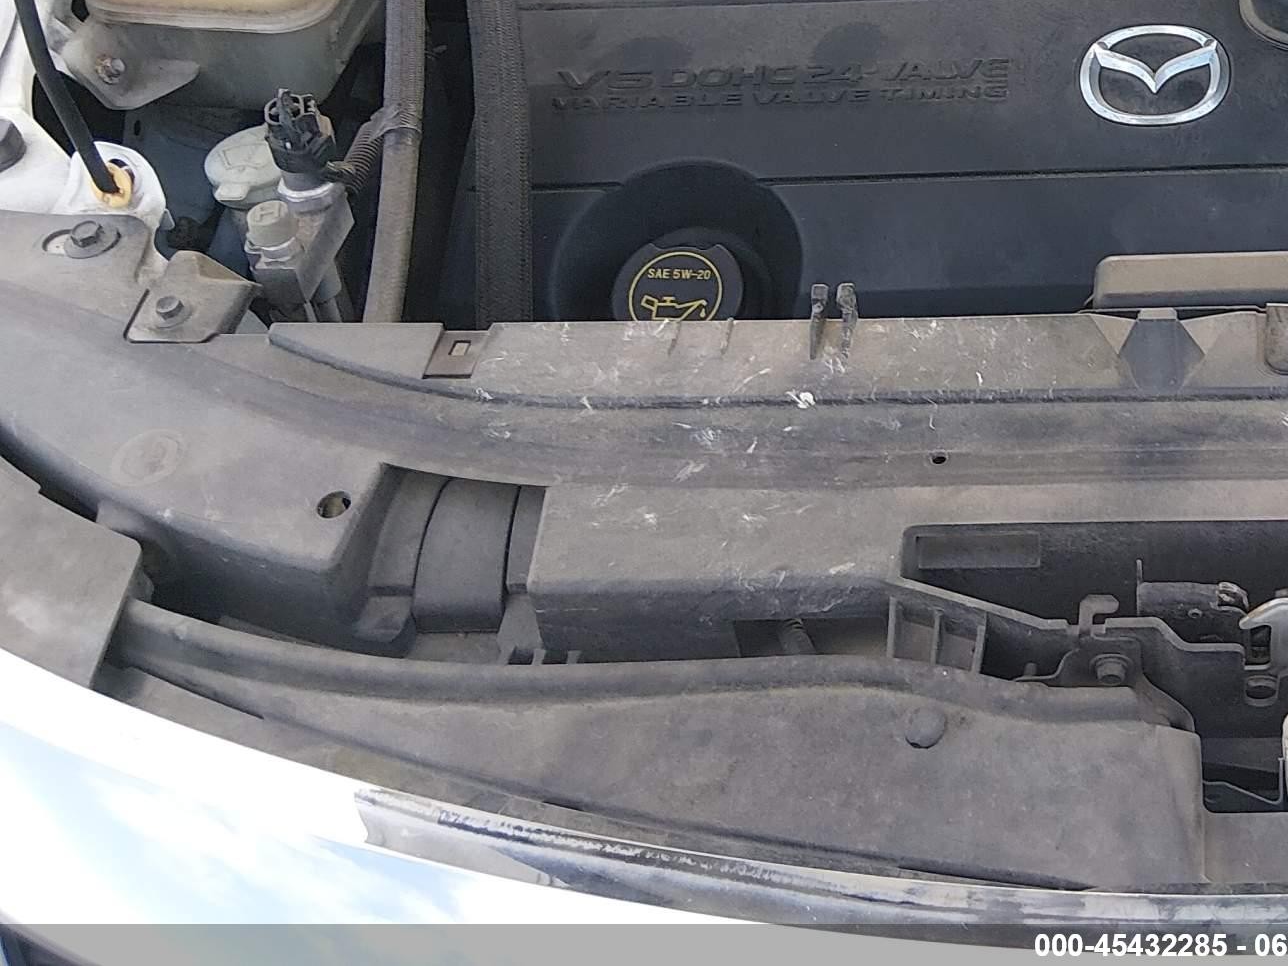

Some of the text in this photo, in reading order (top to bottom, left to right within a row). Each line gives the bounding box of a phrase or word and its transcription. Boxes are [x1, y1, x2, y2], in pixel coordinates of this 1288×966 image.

[661, 65, 799, 88] DOHC
[552, 85, 1009, 110] VARIABLE VALVE TIMING
[647, 268, 712, 280] SAE 5W-20
